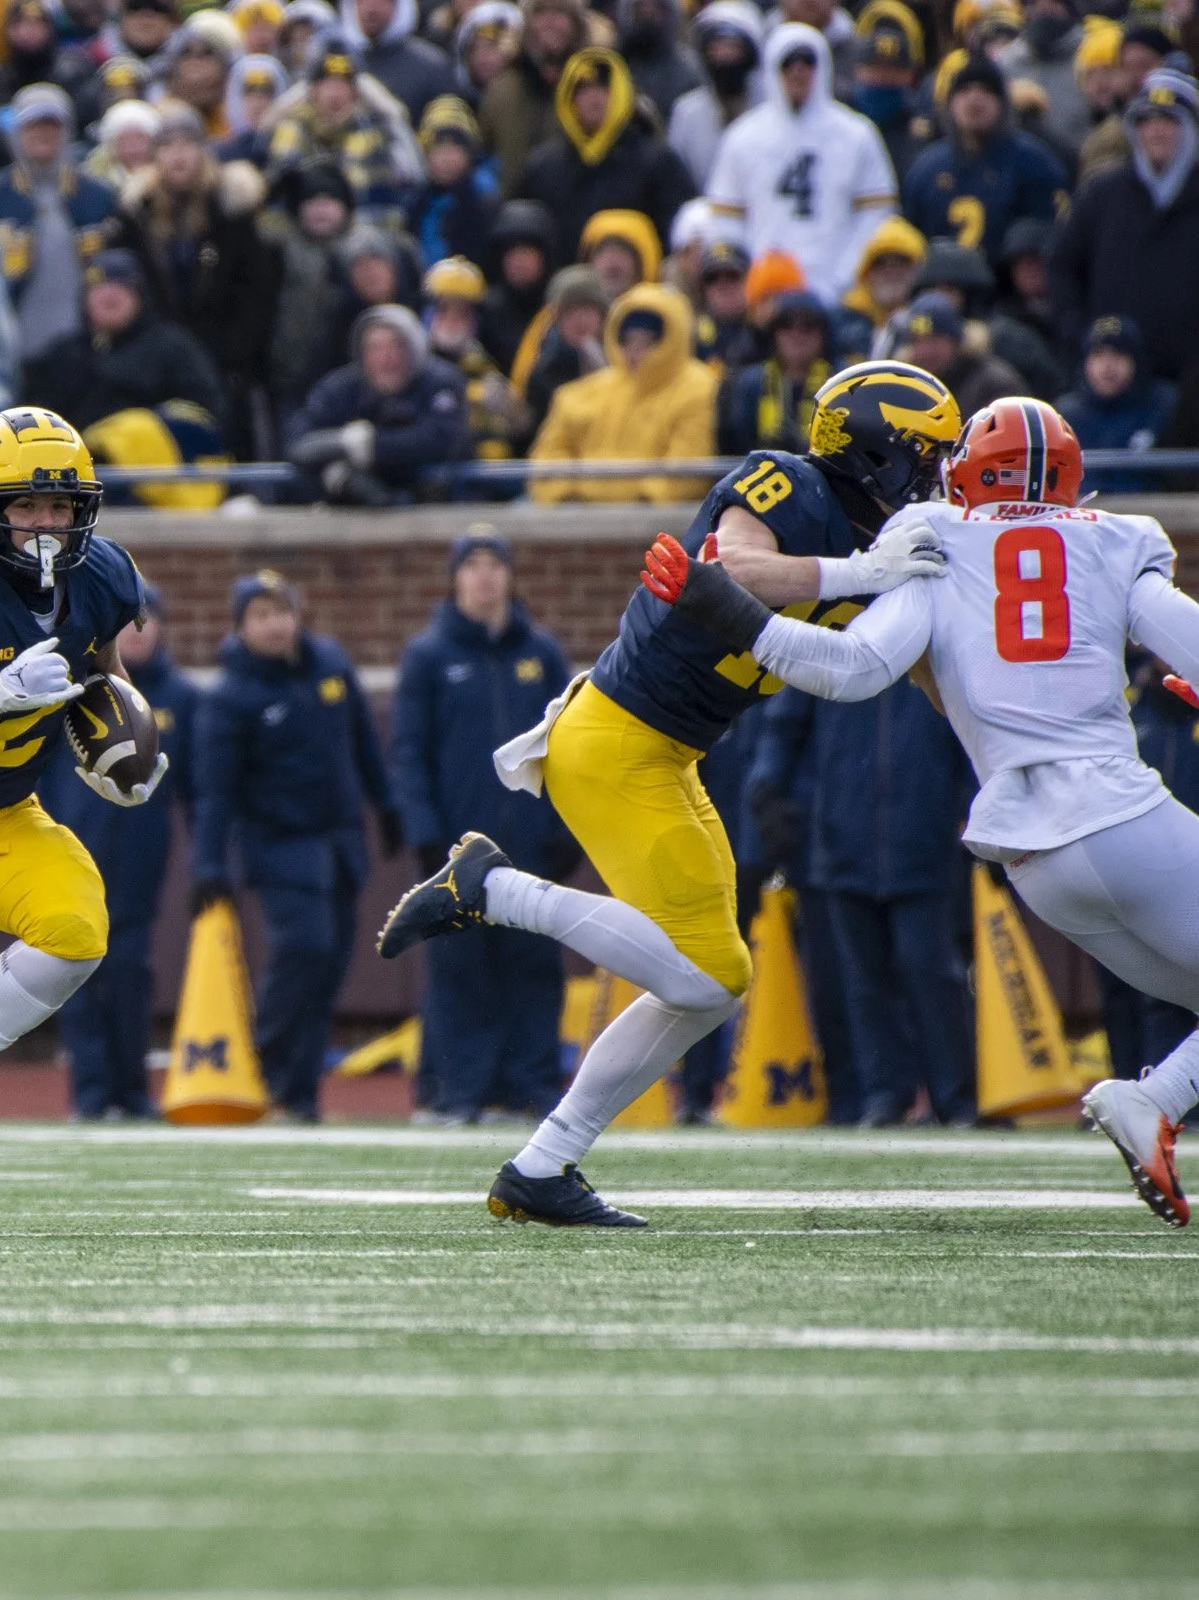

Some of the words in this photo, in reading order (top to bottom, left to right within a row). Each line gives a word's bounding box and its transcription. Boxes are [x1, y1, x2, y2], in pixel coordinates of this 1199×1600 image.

[775, 152, 818, 215] 4
[48, 470, 62, 480] M
[733, 460, 793, 514] 18
[993, 526, 1072, 664] 8
[183, 1036, 230, 1074] M
[765, 1058, 816, 1105] M
